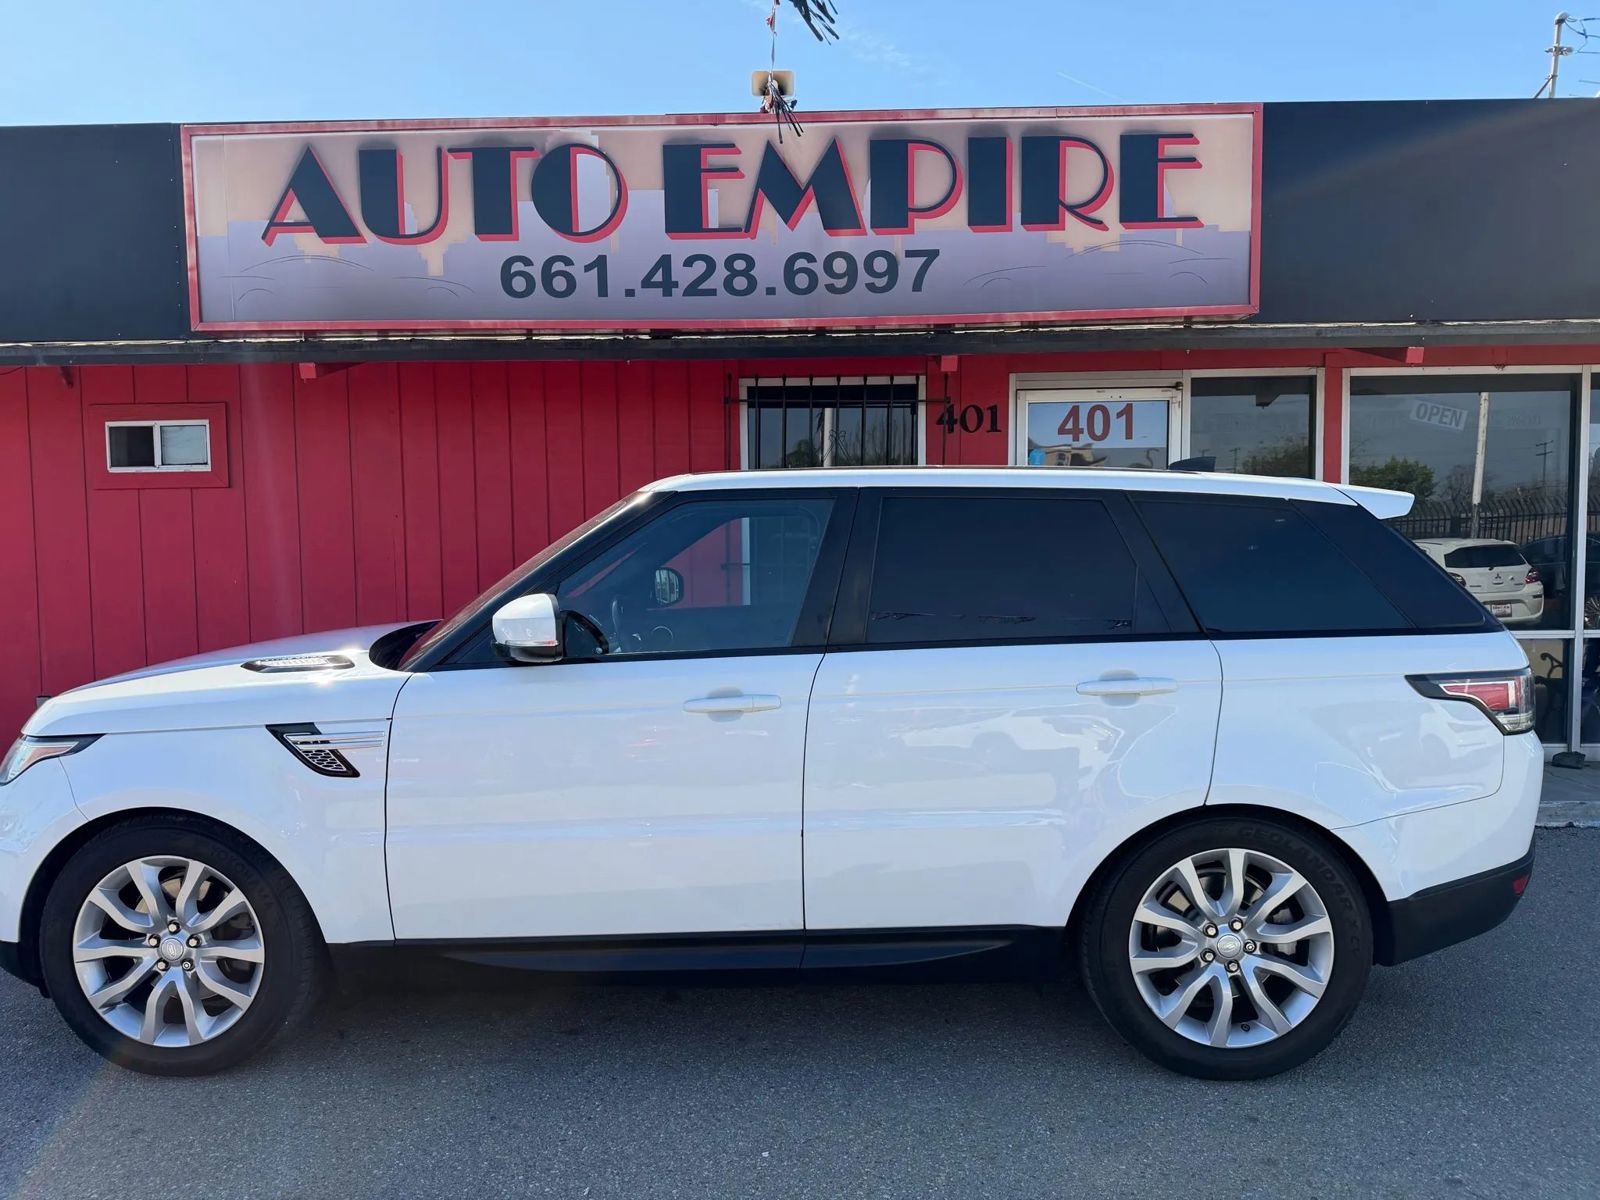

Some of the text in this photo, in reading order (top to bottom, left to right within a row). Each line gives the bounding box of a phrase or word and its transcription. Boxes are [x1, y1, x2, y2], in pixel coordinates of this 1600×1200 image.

[262, 133, 1205, 246] AUTO EMPIRE
[500, 248, 941, 299] 661.428.6997
[935, 404, 1002, 433] 401
[1057, 402, 1135, 442] 401
[1415, 402, 1464, 428] OPEN
